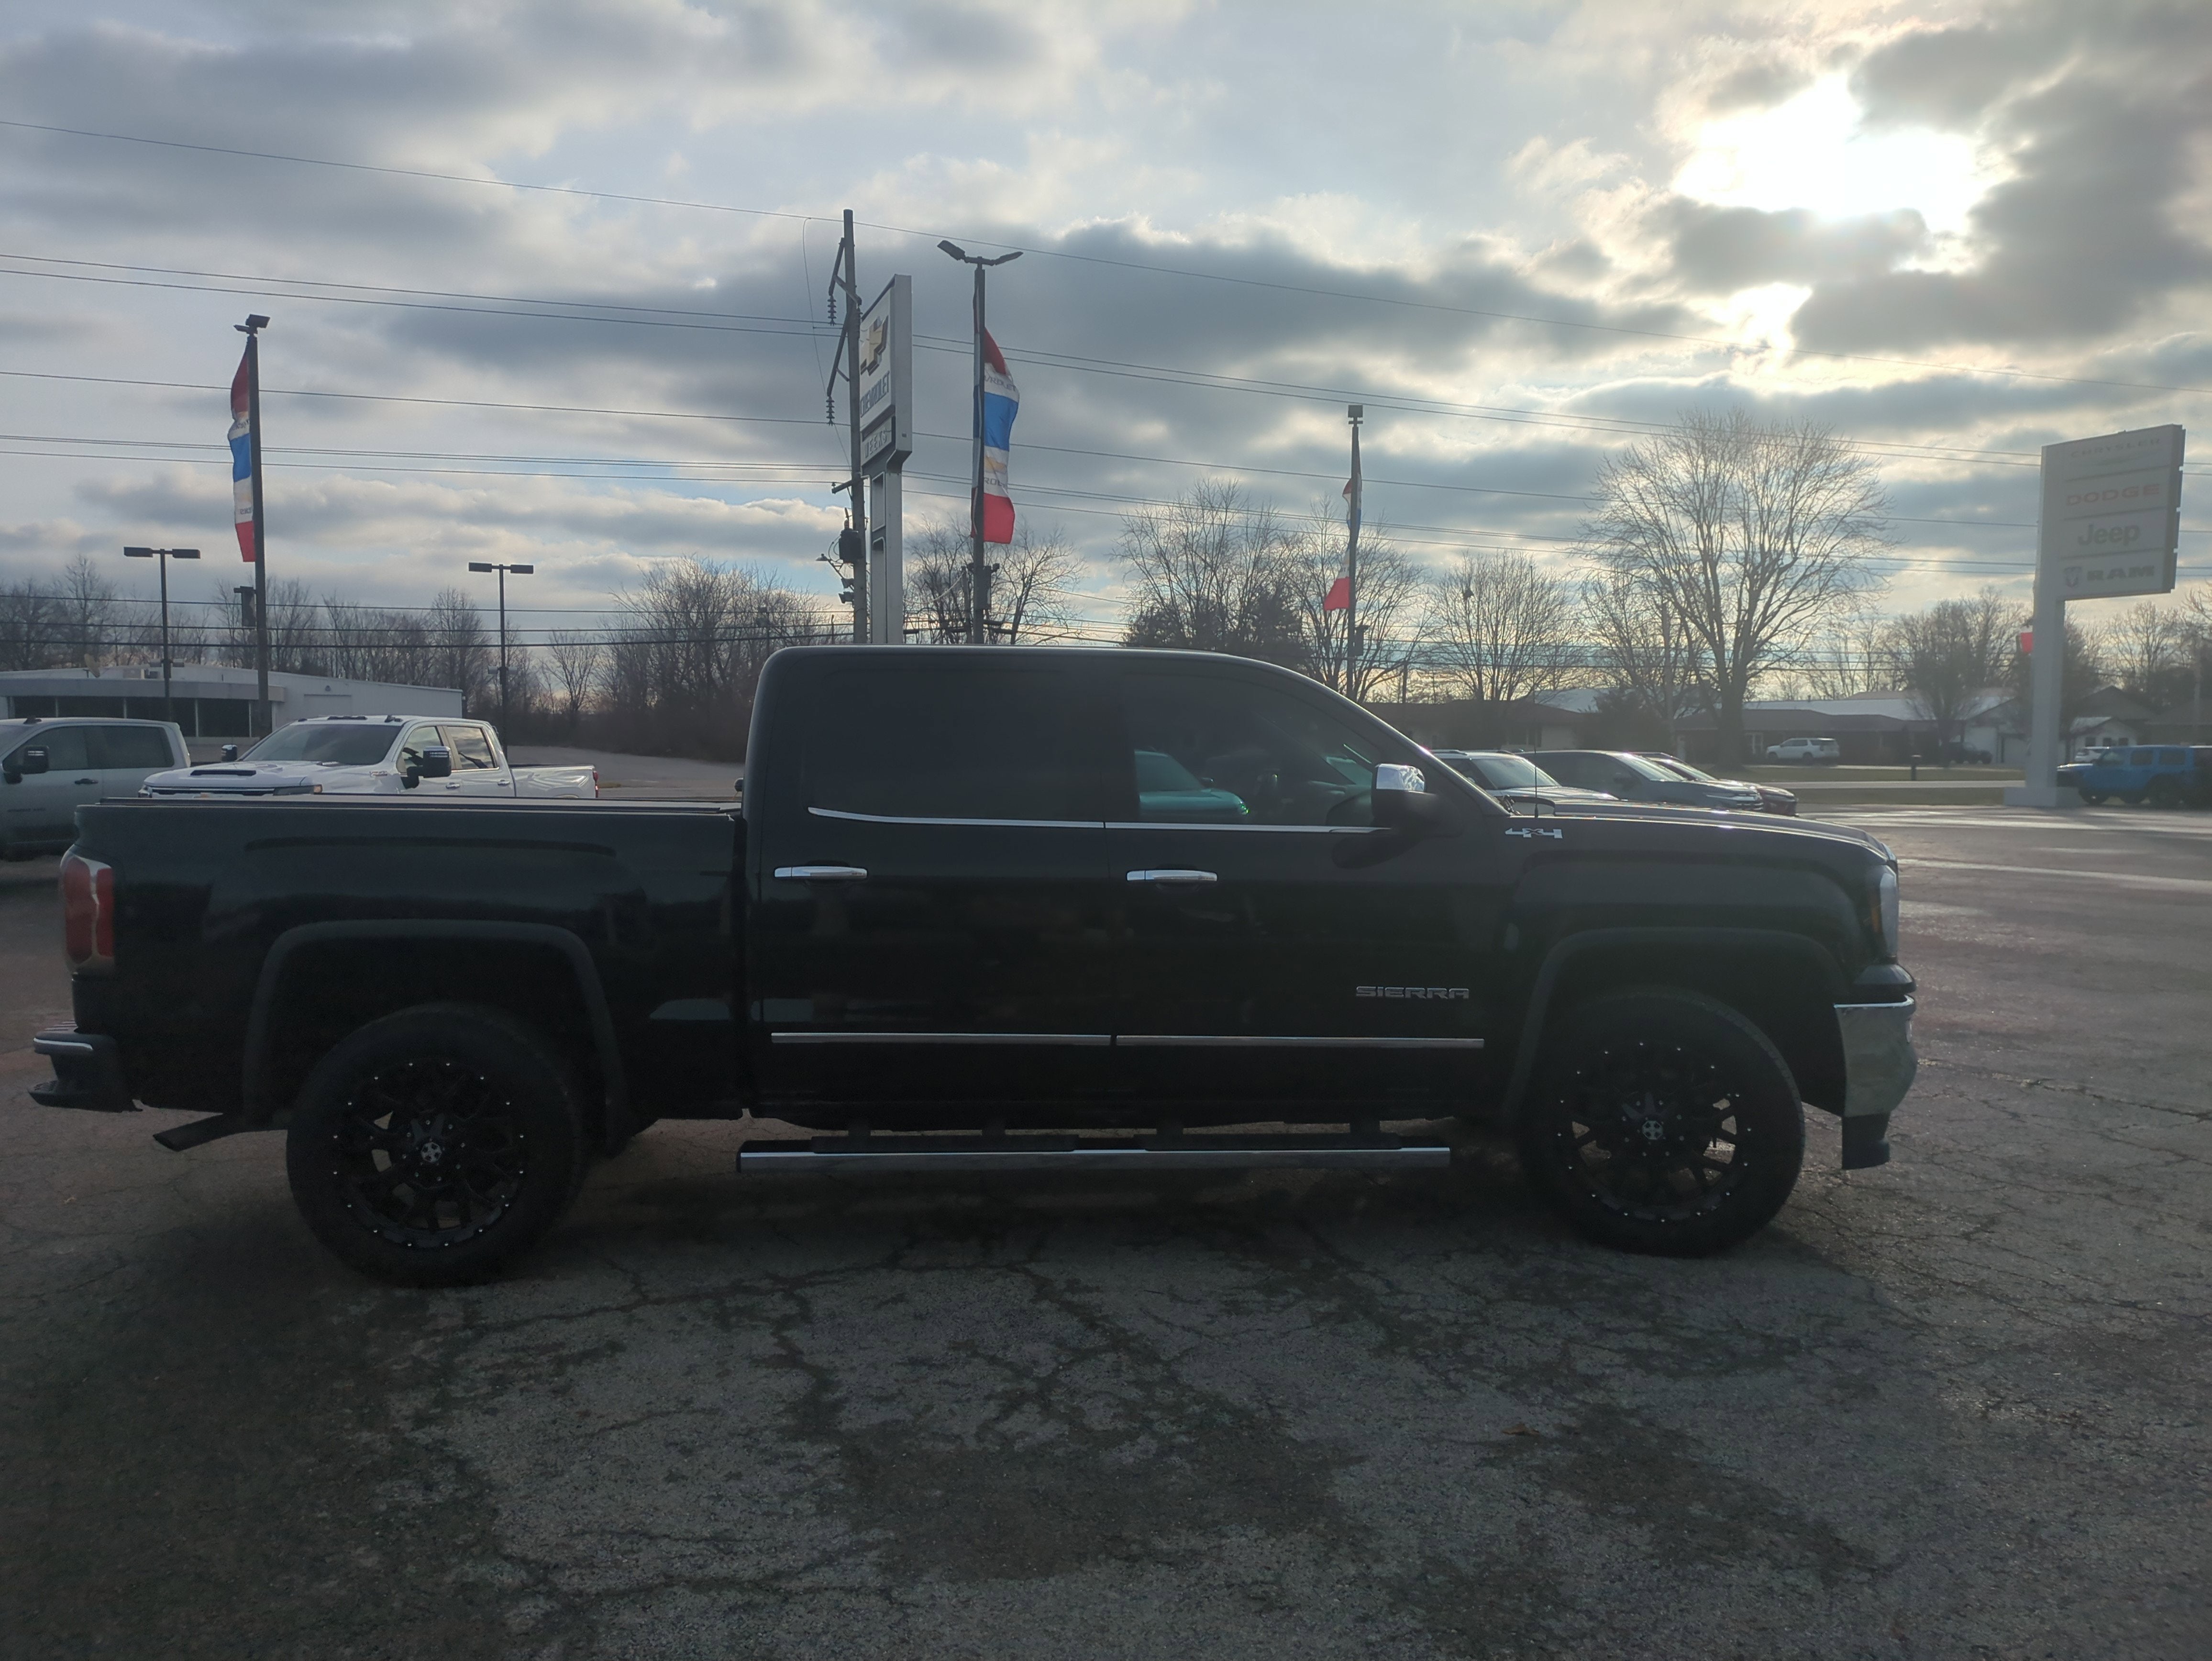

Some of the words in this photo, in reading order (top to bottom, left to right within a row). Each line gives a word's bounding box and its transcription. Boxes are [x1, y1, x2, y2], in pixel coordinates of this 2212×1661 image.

[2070, 438, 2160, 458] CHRYSLER
[2067, 483, 2160, 507] DODGE
[2077, 523, 2141, 546] Jeep
[2086, 565, 2155, 581] RAM
[1356, 986, 1470, 999] SIERRA
